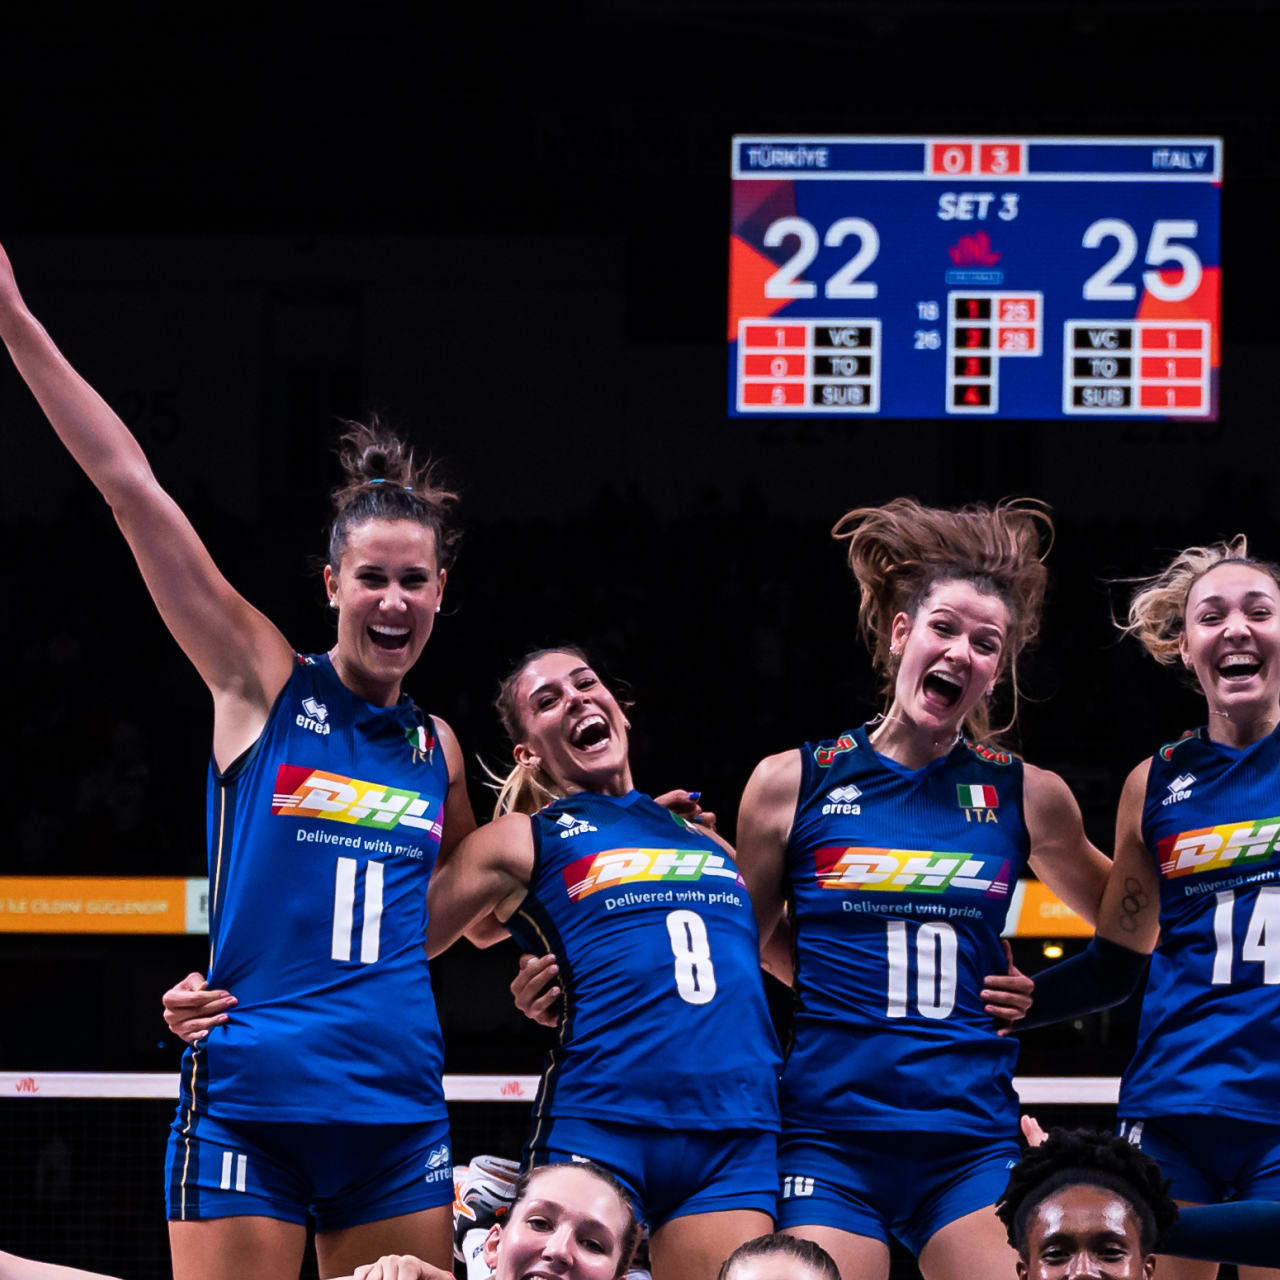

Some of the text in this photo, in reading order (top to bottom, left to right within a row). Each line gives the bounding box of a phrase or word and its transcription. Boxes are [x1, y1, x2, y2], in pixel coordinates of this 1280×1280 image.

[943, 150, 1009, 174] 0 3
[1152, 151, 1206, 169] ITALY
[938, 193, 1020, 221] SET 3
[763, 216, 881, 300] 22
[1082, 218, 1202, 302] 25
[776, 328, 858, 347] 1 VC
[1089, 330, 1176, 349] VC 1
[828, 358, 857, 376] TO
[1089, 359, 1176, 378] TO 1
[822, 386, 863, 405] SUB
[1082, 388, 1176, 407] SUB 1
[298, 777, 434, 830] DHL
[965, 808, 998, 823] ITA
[296, 829, 423, 859] Delivered with pride.
[594, 853, 737, 883] DHL
[831, 854, 991, 891] DHL
[1185, 874, 1244, 897] Delivered
[1246, 870, 1275, 882] with
[331, 857, 384, 964] 11
[605, 890, 743, 910] Delivered with pride.
[842, 901, 983, 919] Delivered with pride.
[666, 910, 717, 1005] 8
[887, 920, 958, 1019] 10
[220, 1151, 247, 1192] 11
